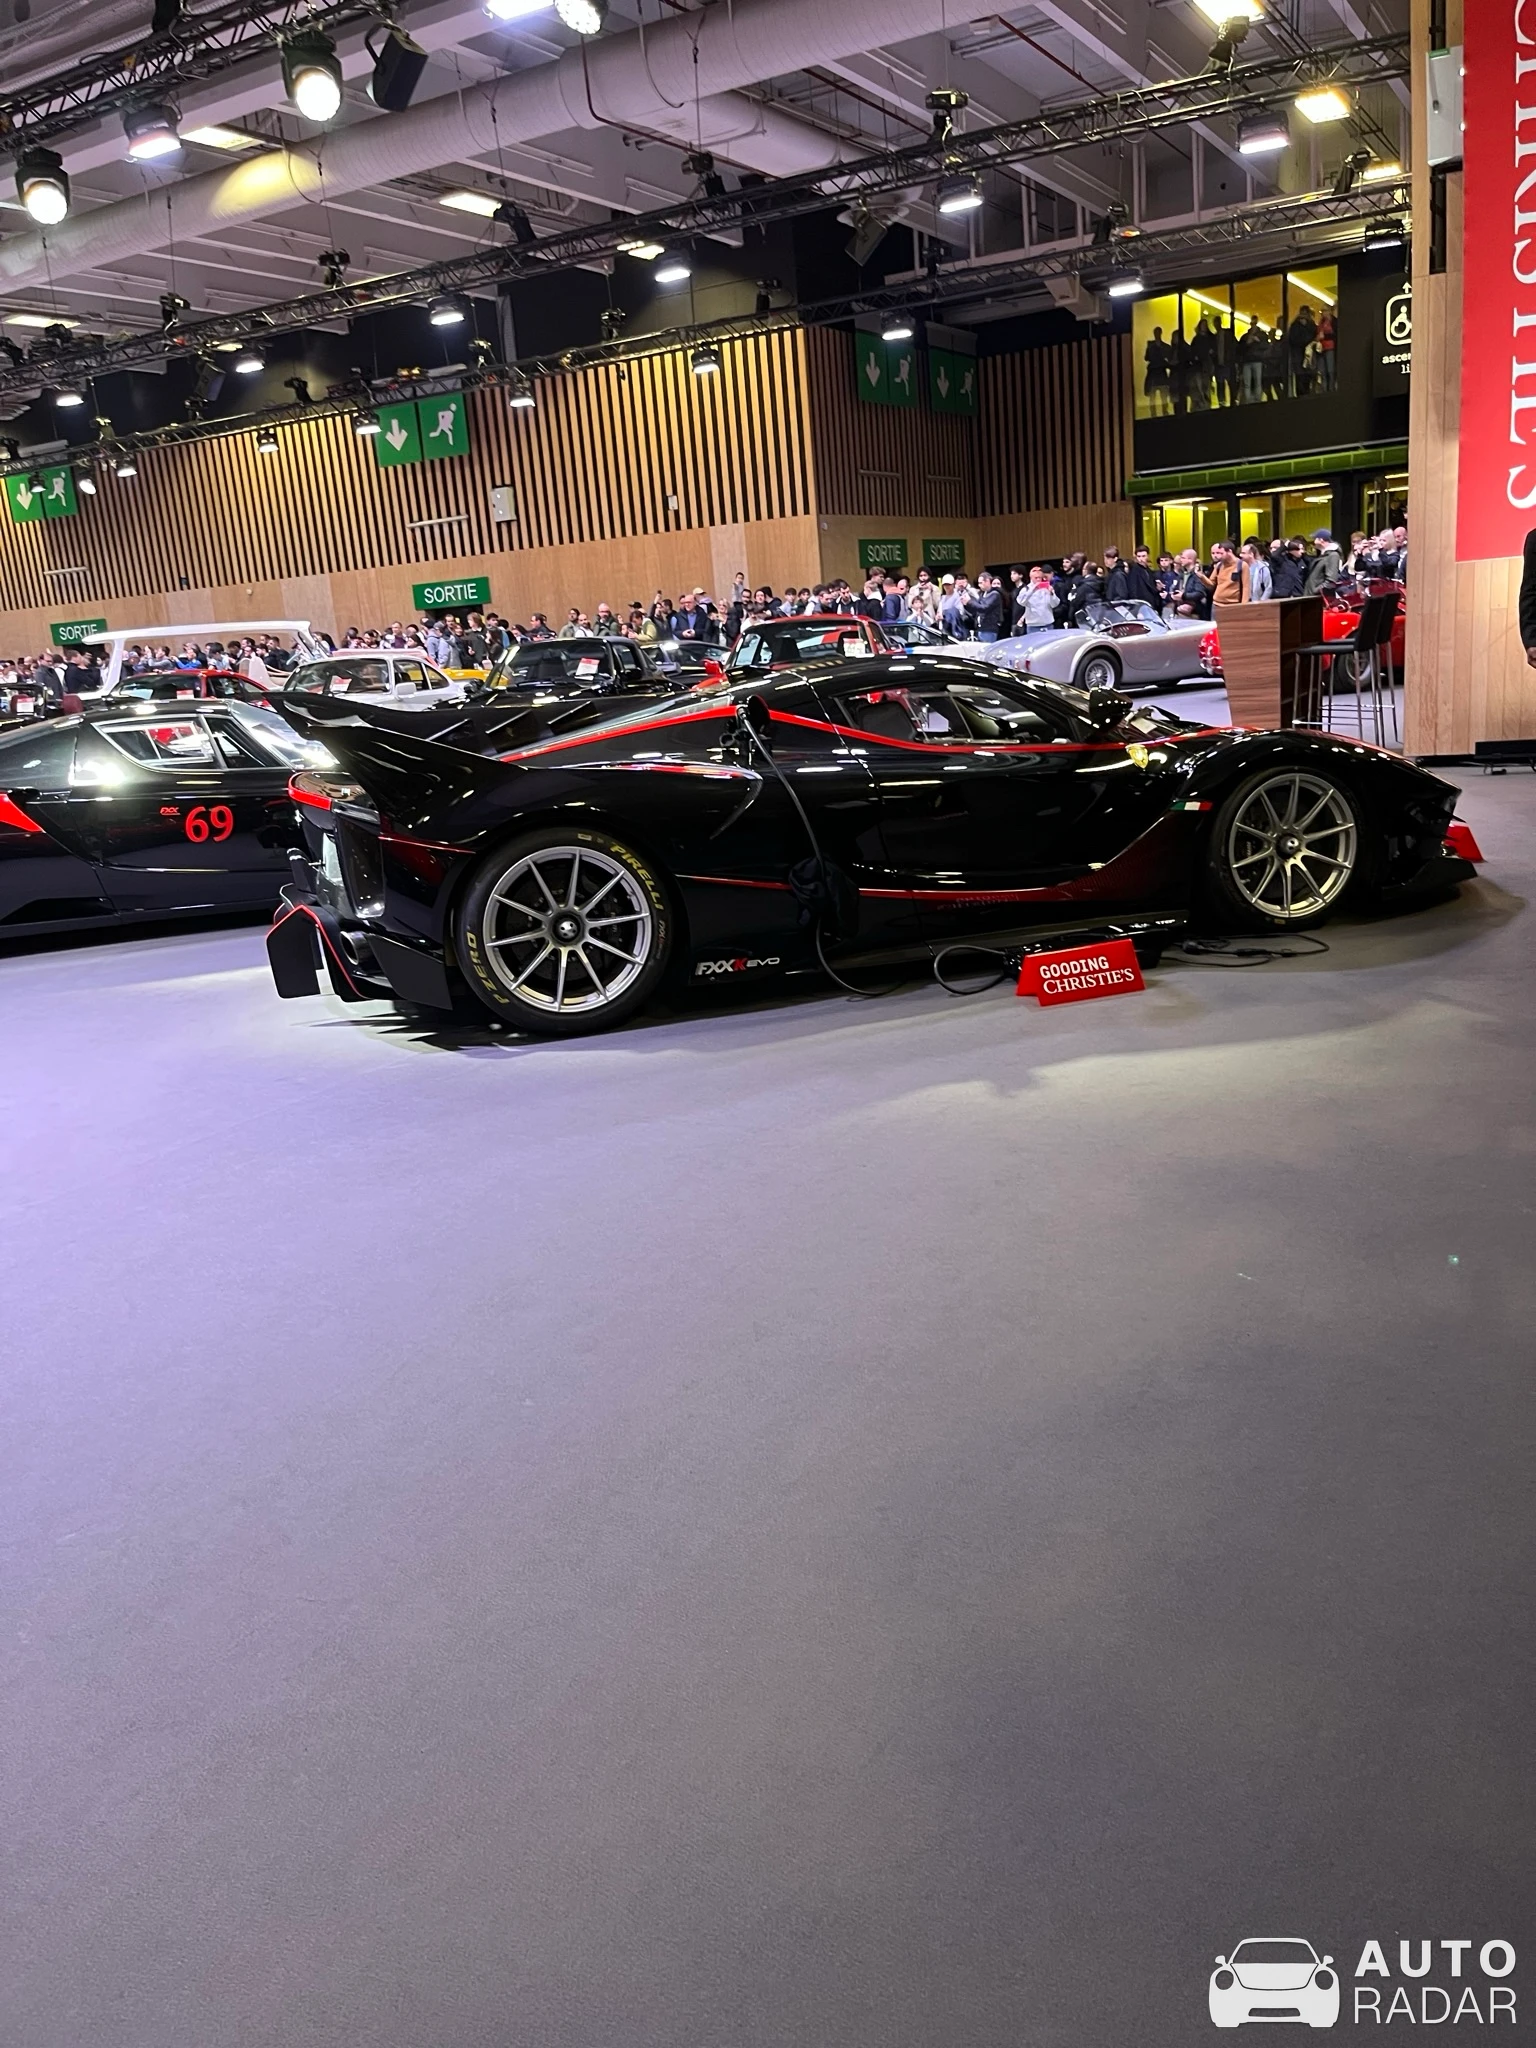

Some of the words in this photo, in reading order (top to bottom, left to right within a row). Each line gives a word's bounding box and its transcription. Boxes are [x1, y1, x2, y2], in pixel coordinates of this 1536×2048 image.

[867, 544, 902, 562] SORTIE
[930, 544, 961, 561] SORTIE
[424, 583, 478, 604] SORTIE
[185, 805, 234, 843] 69
[610, 844, 665, 910] PIRELLI
[1039, 956, 1109, 979] GOODING
[1043, 968, 1135, 994] CHRISTIE'S
